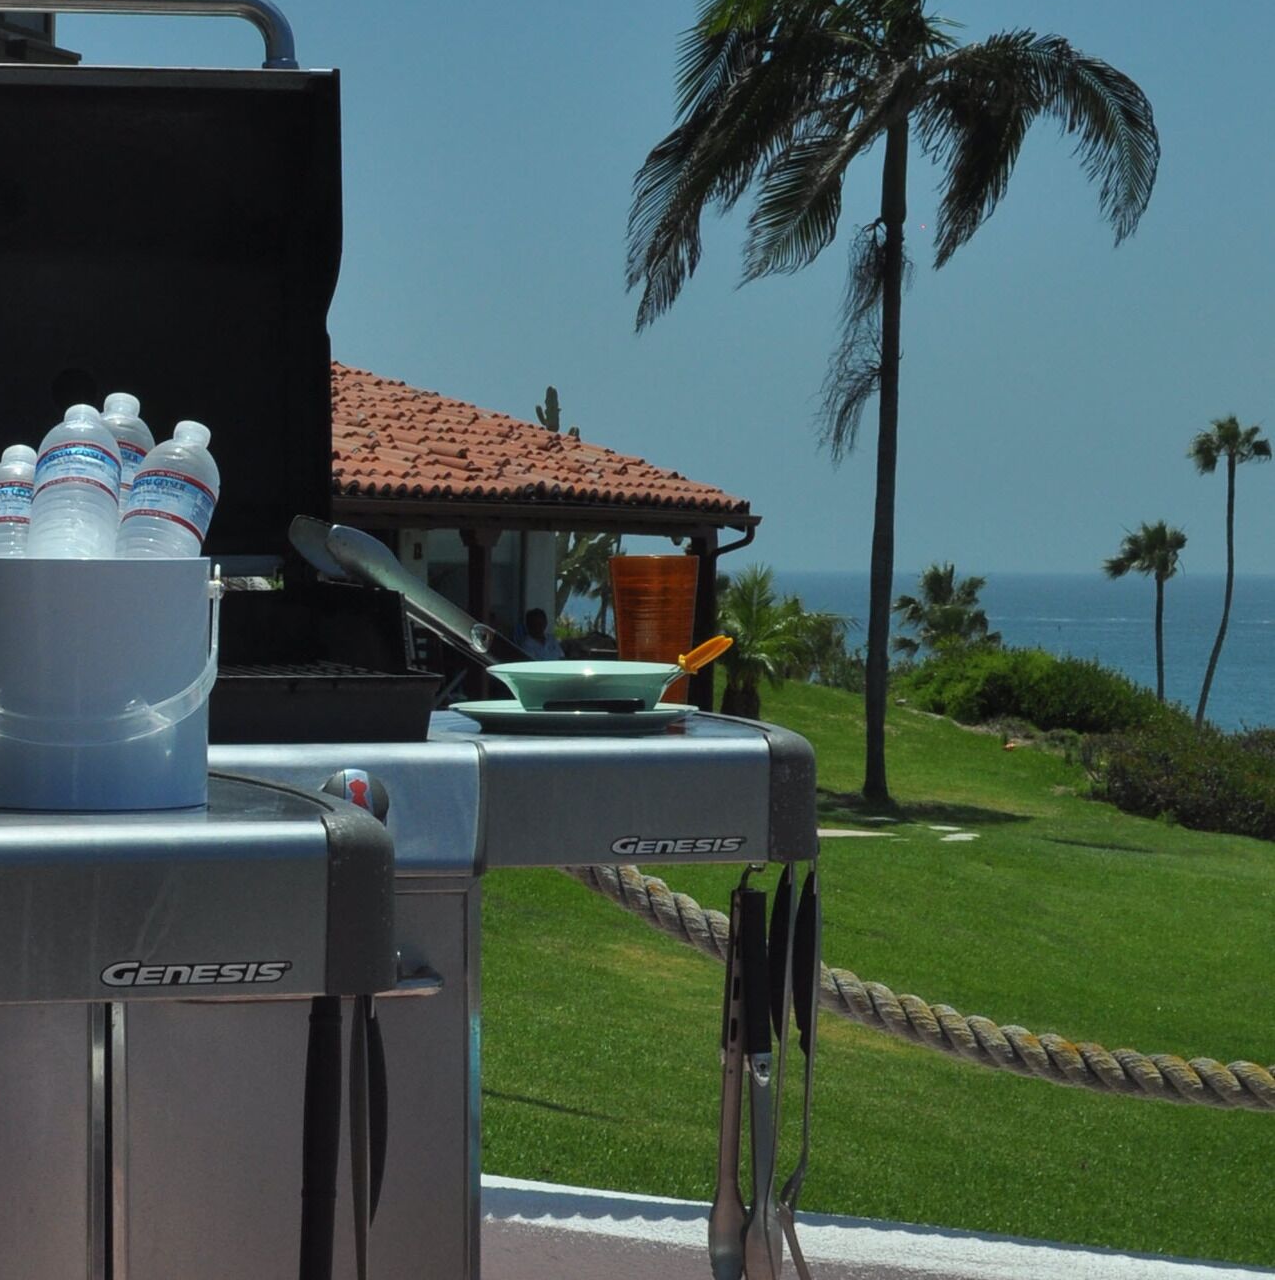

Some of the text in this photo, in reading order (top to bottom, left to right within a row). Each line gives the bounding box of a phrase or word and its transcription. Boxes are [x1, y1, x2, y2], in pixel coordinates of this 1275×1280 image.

[153, 477, 185, 491] GEYSER
[611, 836, 744, 855] GENESIS
[100, 960, 288, 987] GENESIS
